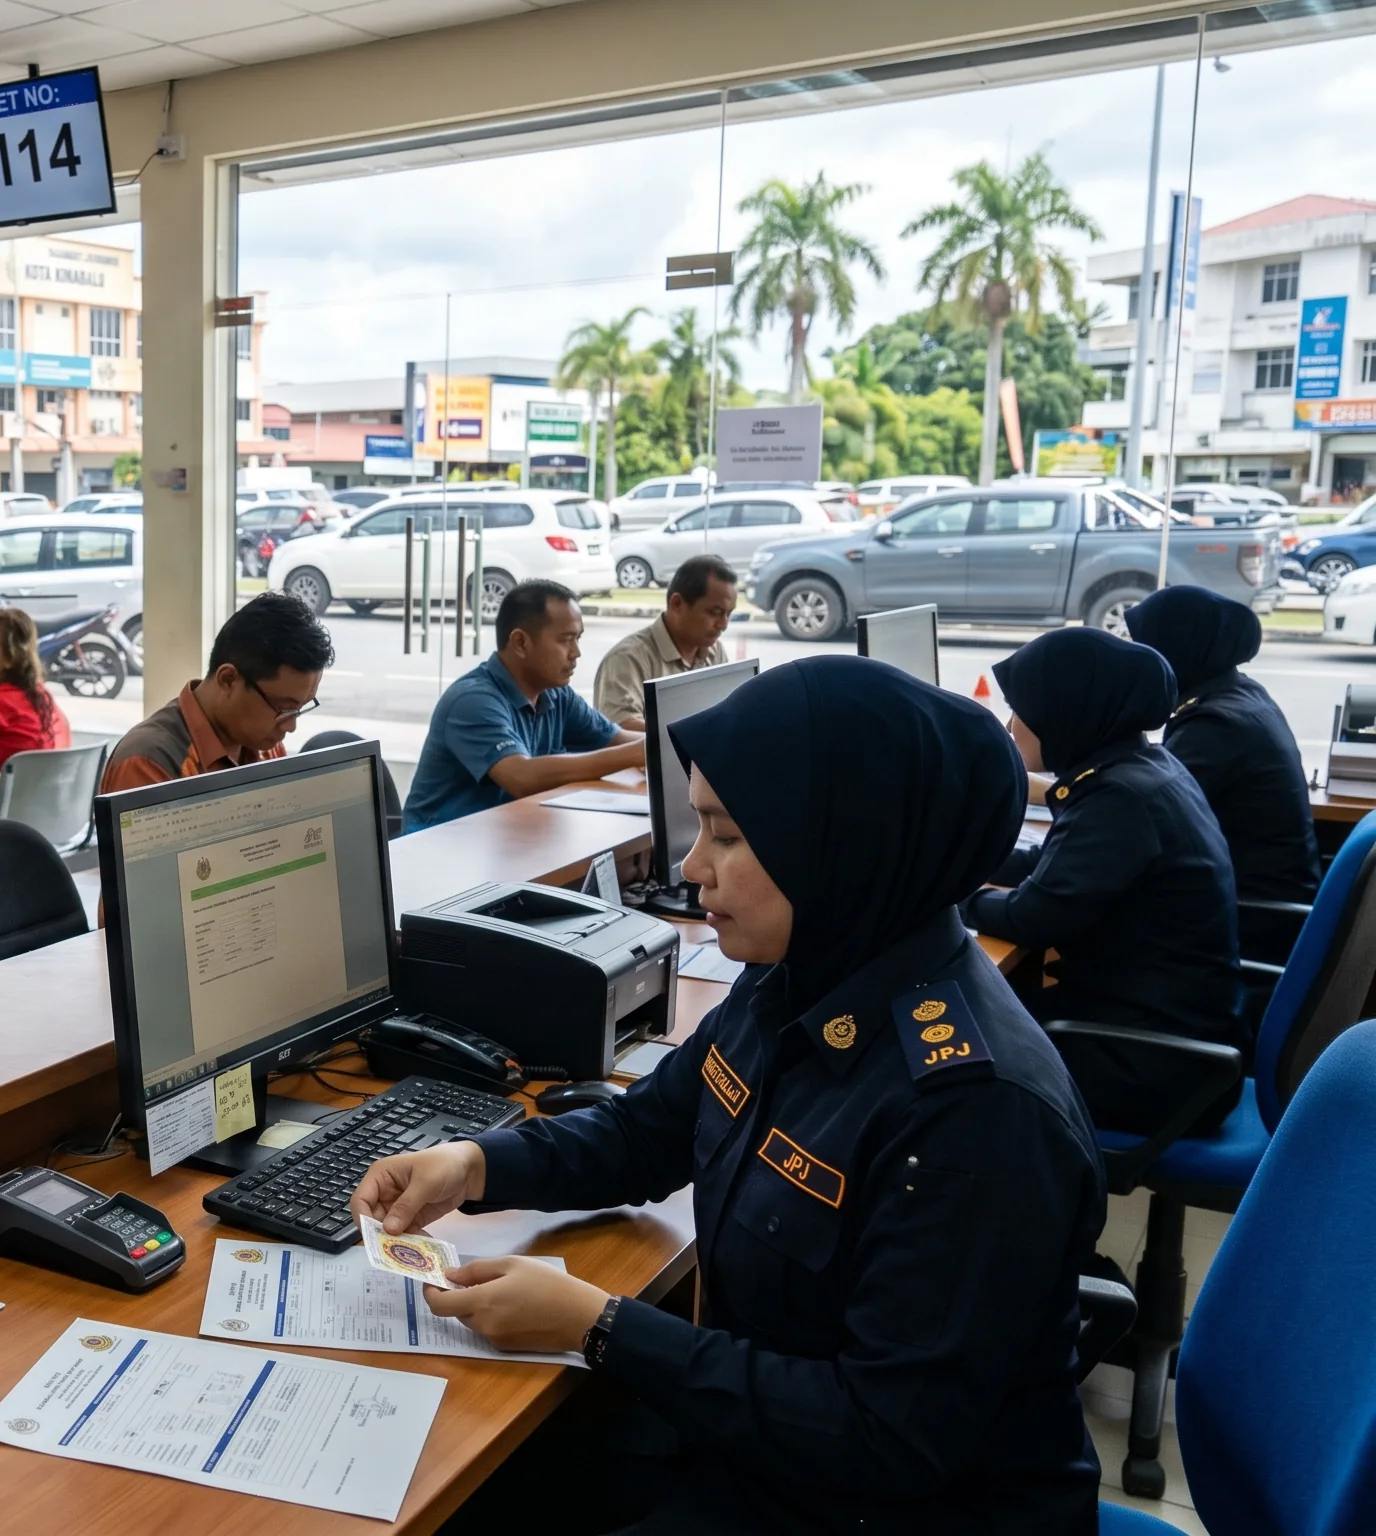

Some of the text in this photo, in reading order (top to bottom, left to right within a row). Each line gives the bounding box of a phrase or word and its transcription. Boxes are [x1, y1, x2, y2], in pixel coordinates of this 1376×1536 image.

[24, 84, 60, 107] NO:
[924, 1042, 971, 1065] JPJ
[783, 1152, 811, 1180] JPJ
